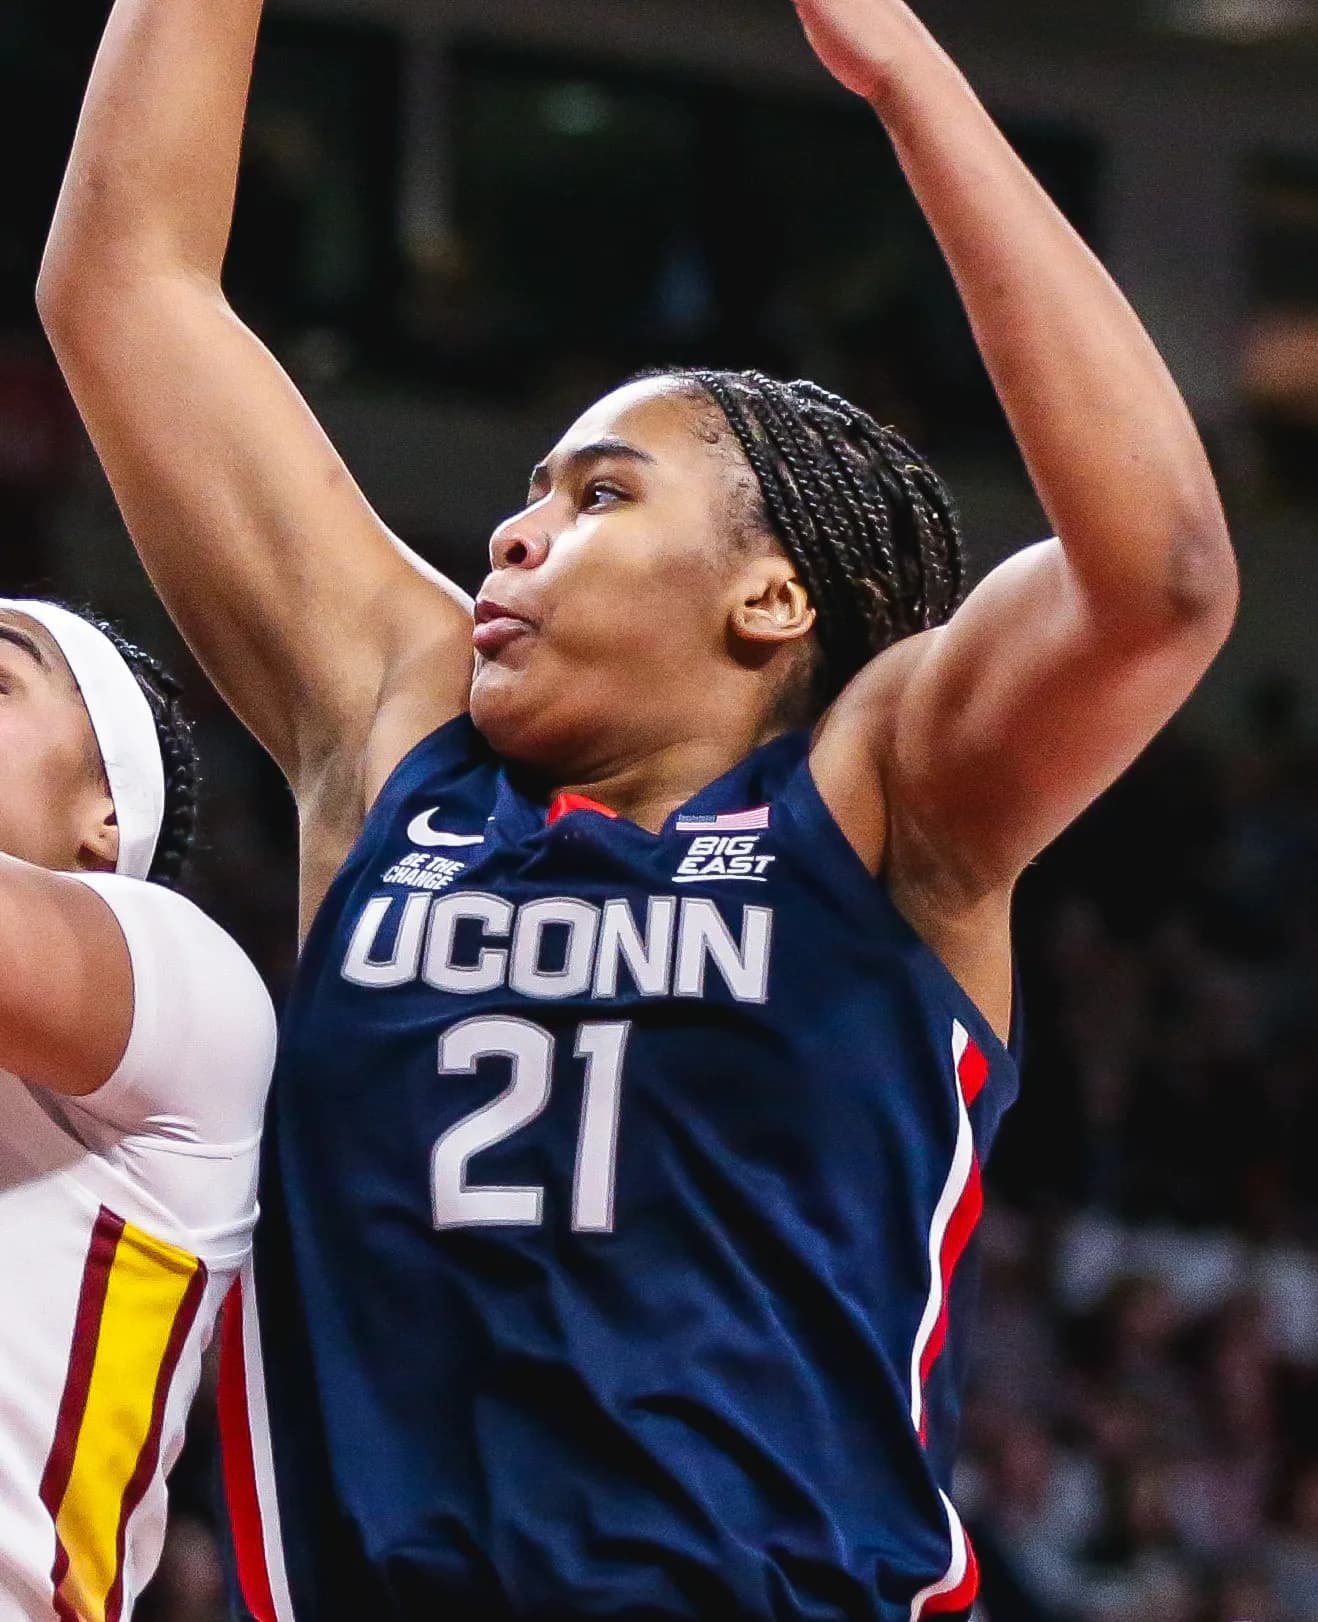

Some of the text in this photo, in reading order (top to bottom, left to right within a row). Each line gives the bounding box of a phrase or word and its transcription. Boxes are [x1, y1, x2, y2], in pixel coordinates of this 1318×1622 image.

[687, 835, 761, 856] BIG
[399, 852, 465, 876] BE THE
[676, 855, 776, 874] EAST
[382, 865, 454, 890] CHANGE
[341, 890, 773, 1004] UCONN
[430, 1014, 633, 1233] 21
